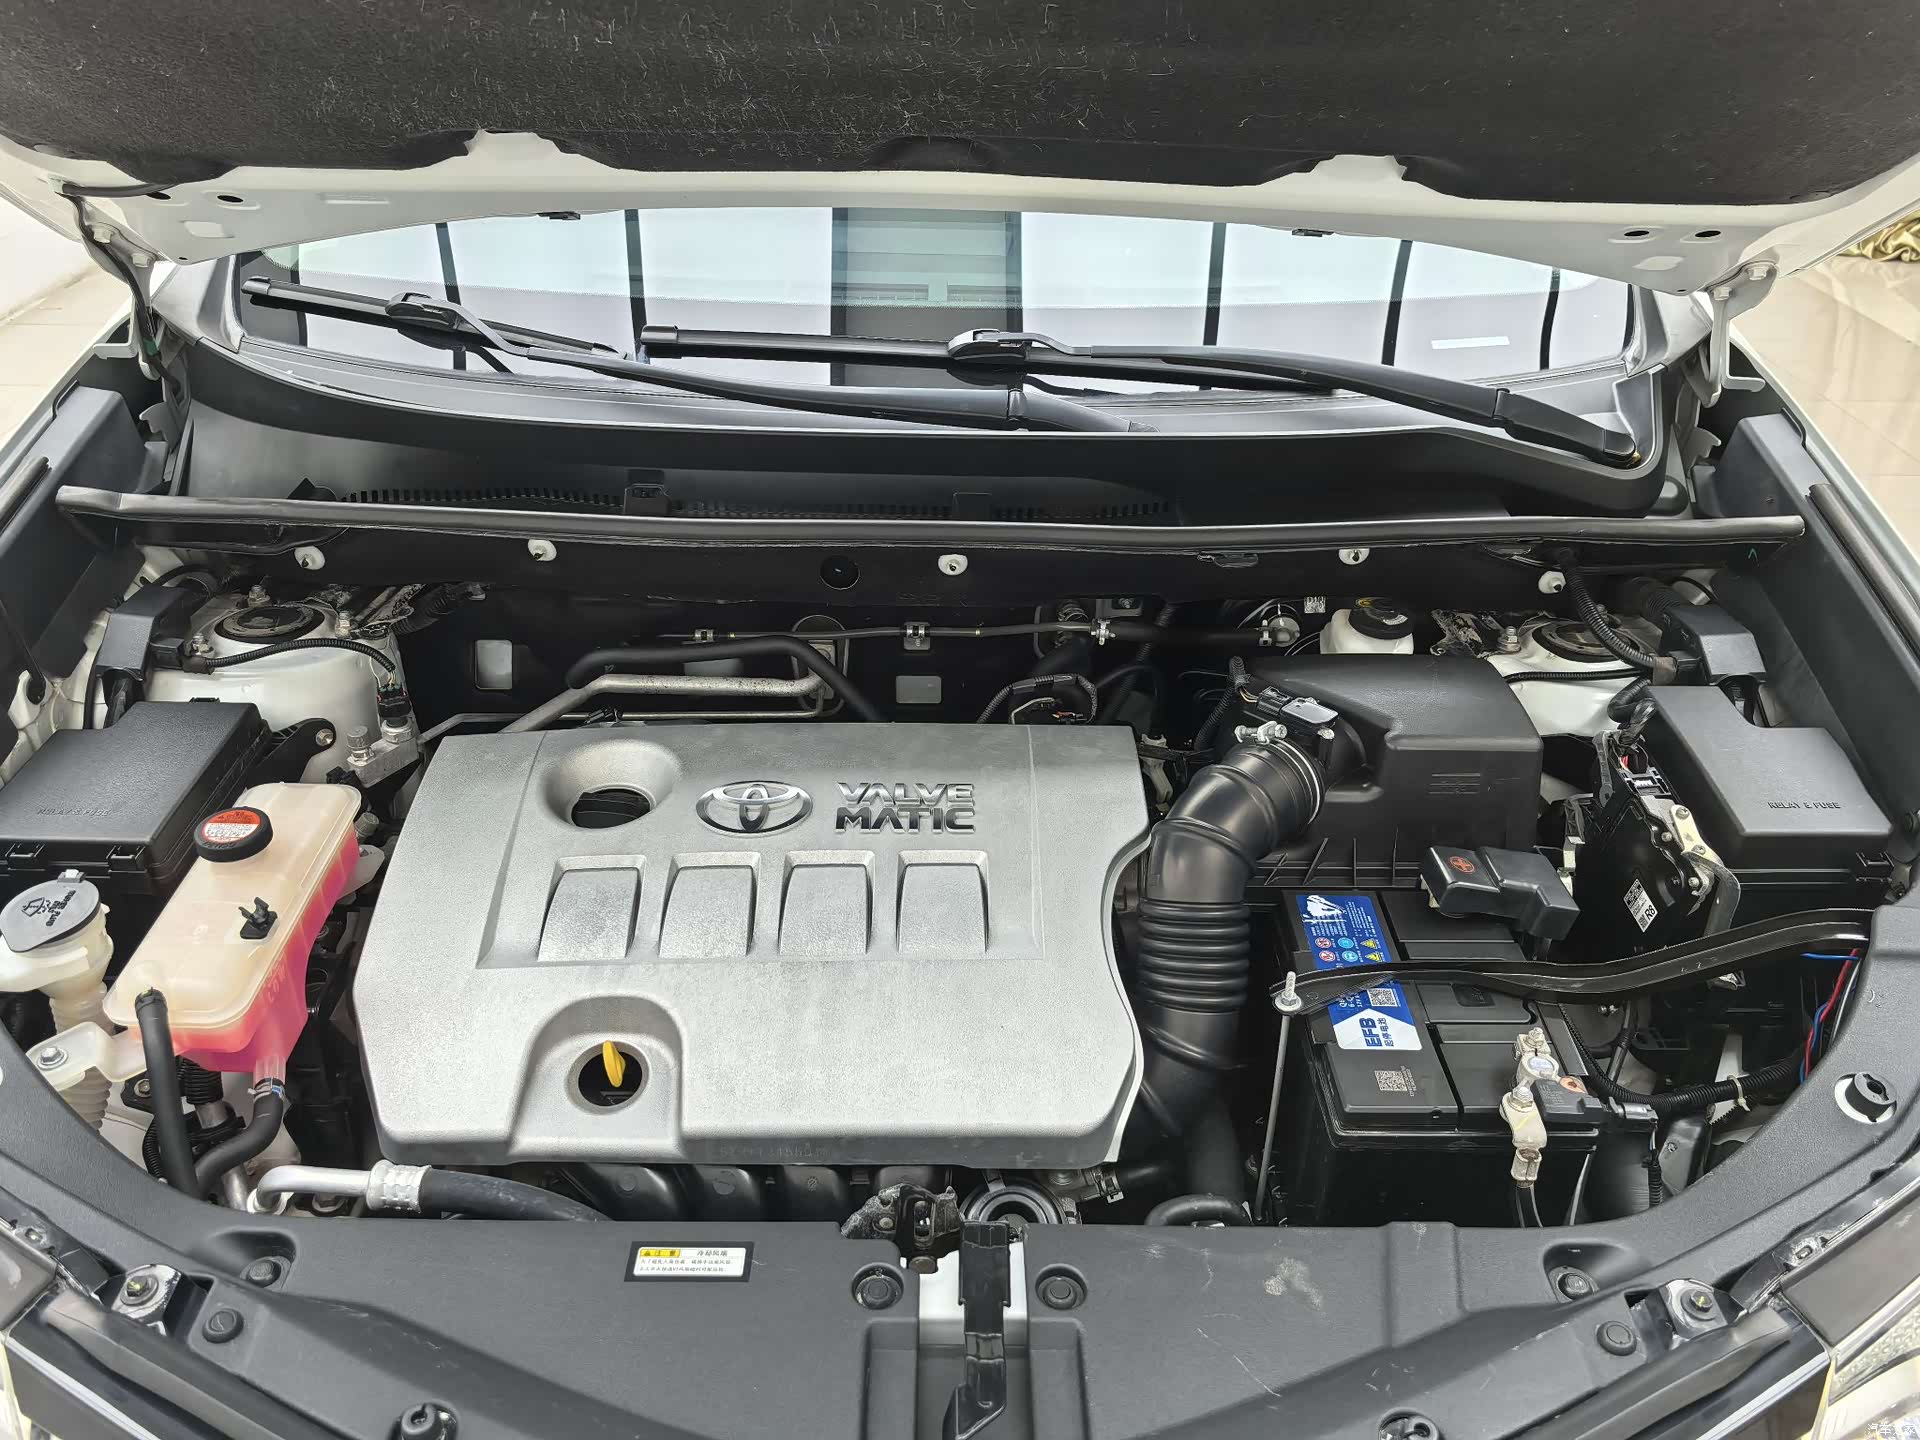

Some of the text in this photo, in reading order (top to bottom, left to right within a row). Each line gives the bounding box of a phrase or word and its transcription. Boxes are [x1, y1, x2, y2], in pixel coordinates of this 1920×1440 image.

[837, 782, 975, 806] VALVE
[1767, 801, 1801, 809] RELAY
[1813, 801, 1842, 809] FUSE
[835, 806, 976, 834] MATIC
[1644, 904, 1656, 921] R8
[1359, 1018, 1383, 1047] EFB
[1377, 1018, 1395, 1047] 起停电池
